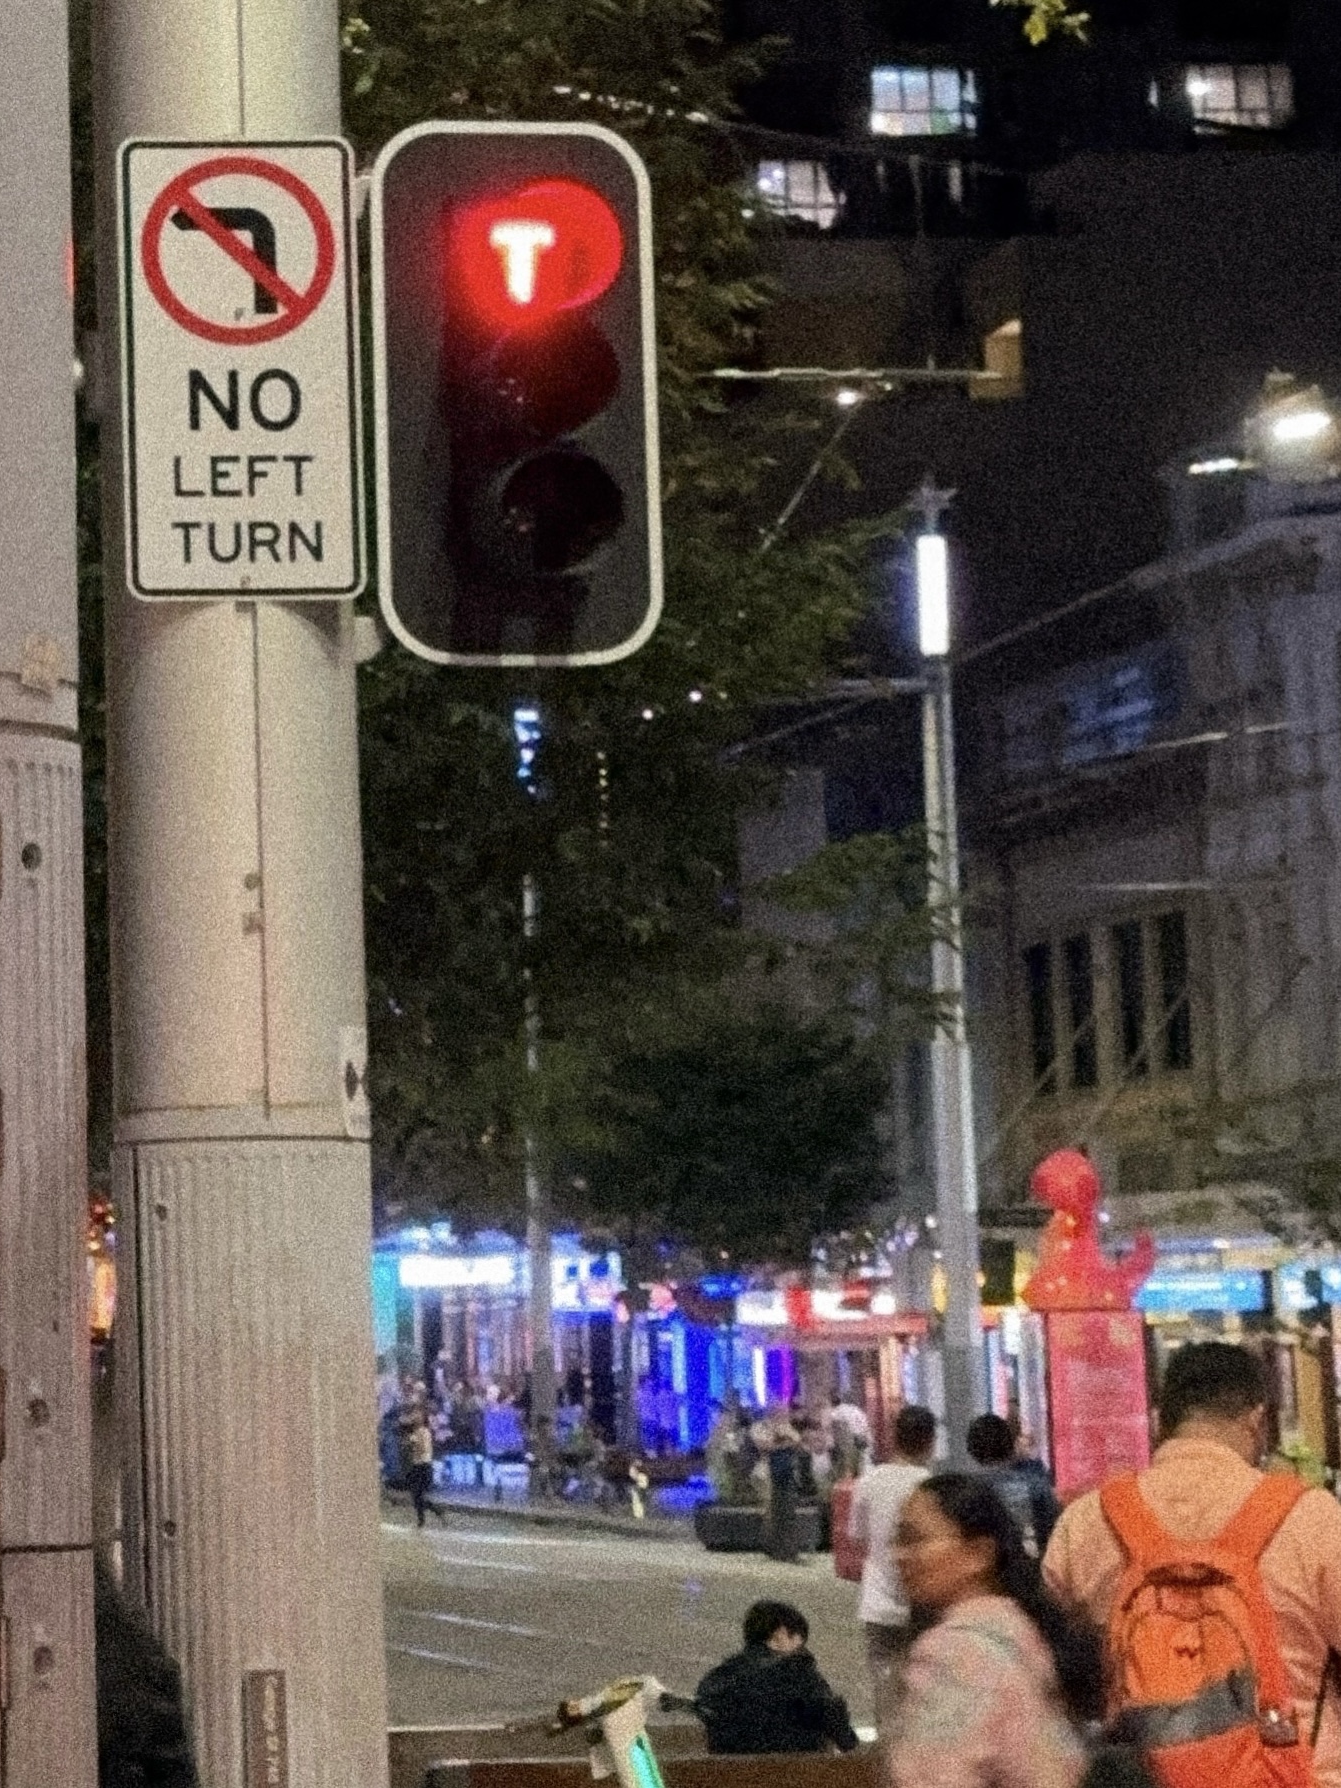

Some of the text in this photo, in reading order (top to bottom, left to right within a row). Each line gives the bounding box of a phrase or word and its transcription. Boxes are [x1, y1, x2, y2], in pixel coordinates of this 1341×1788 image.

[187, 367, 303, 432] NO
[172, 455, 315, 498] LEFT
[171, 520, 324, 564] TURN
